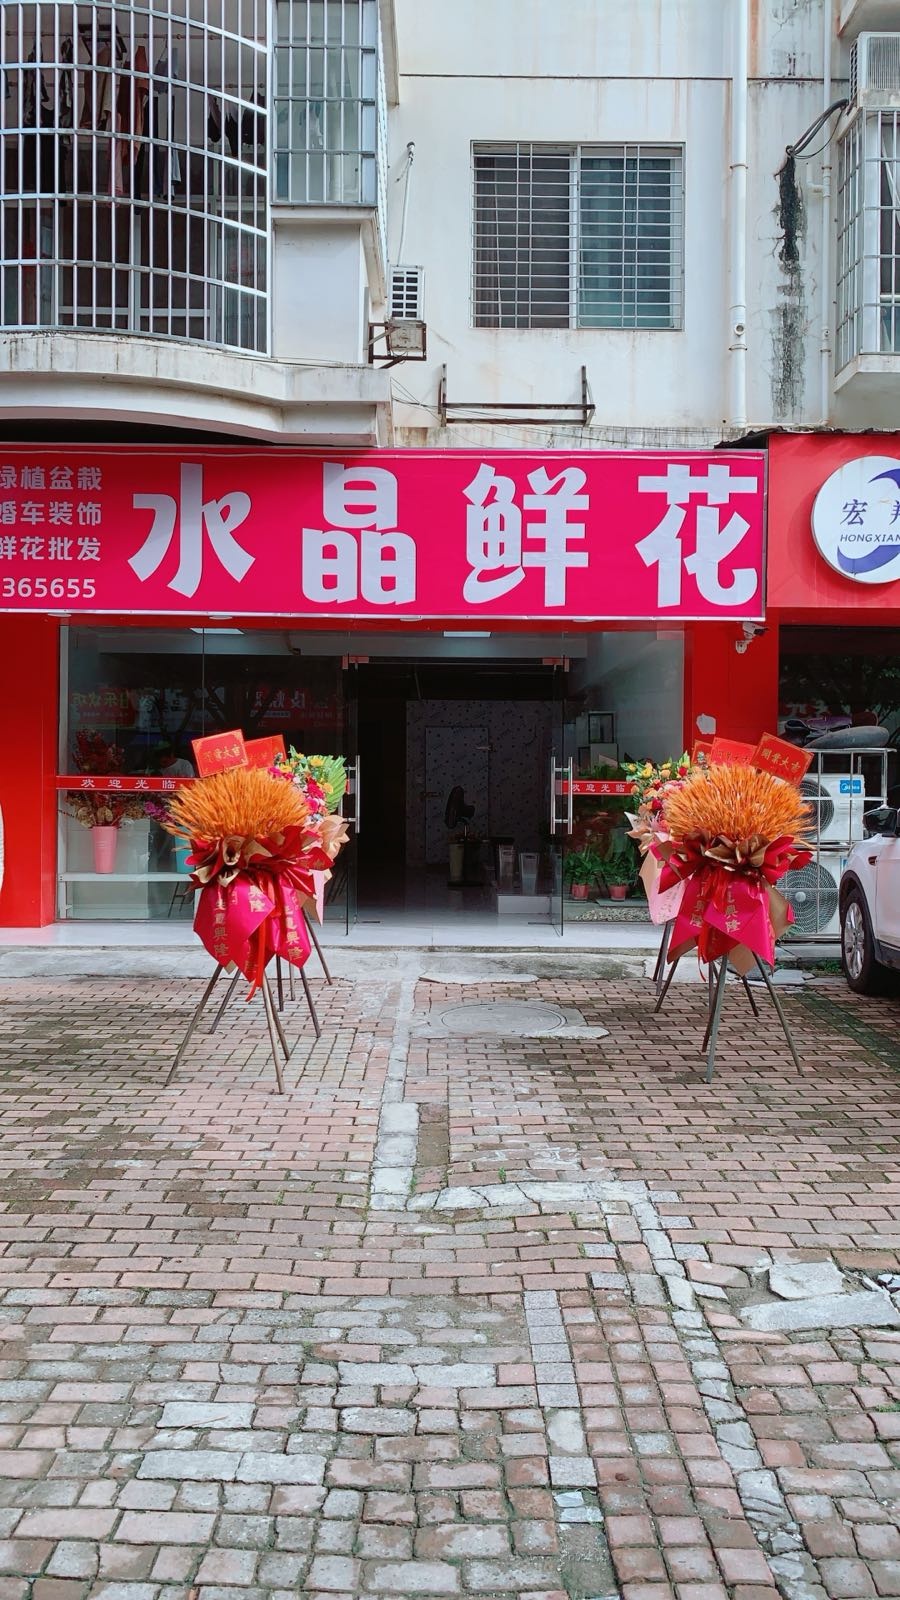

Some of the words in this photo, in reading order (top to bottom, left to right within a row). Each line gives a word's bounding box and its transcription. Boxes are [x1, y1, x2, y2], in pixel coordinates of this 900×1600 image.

[127, 462, 758, 607] 水晶鲜花
[0, 535, 101, 561] 鲜花批发
[2, 577, 97, 598] 365655
[81, 778, 176, 789] 欢迎光临
